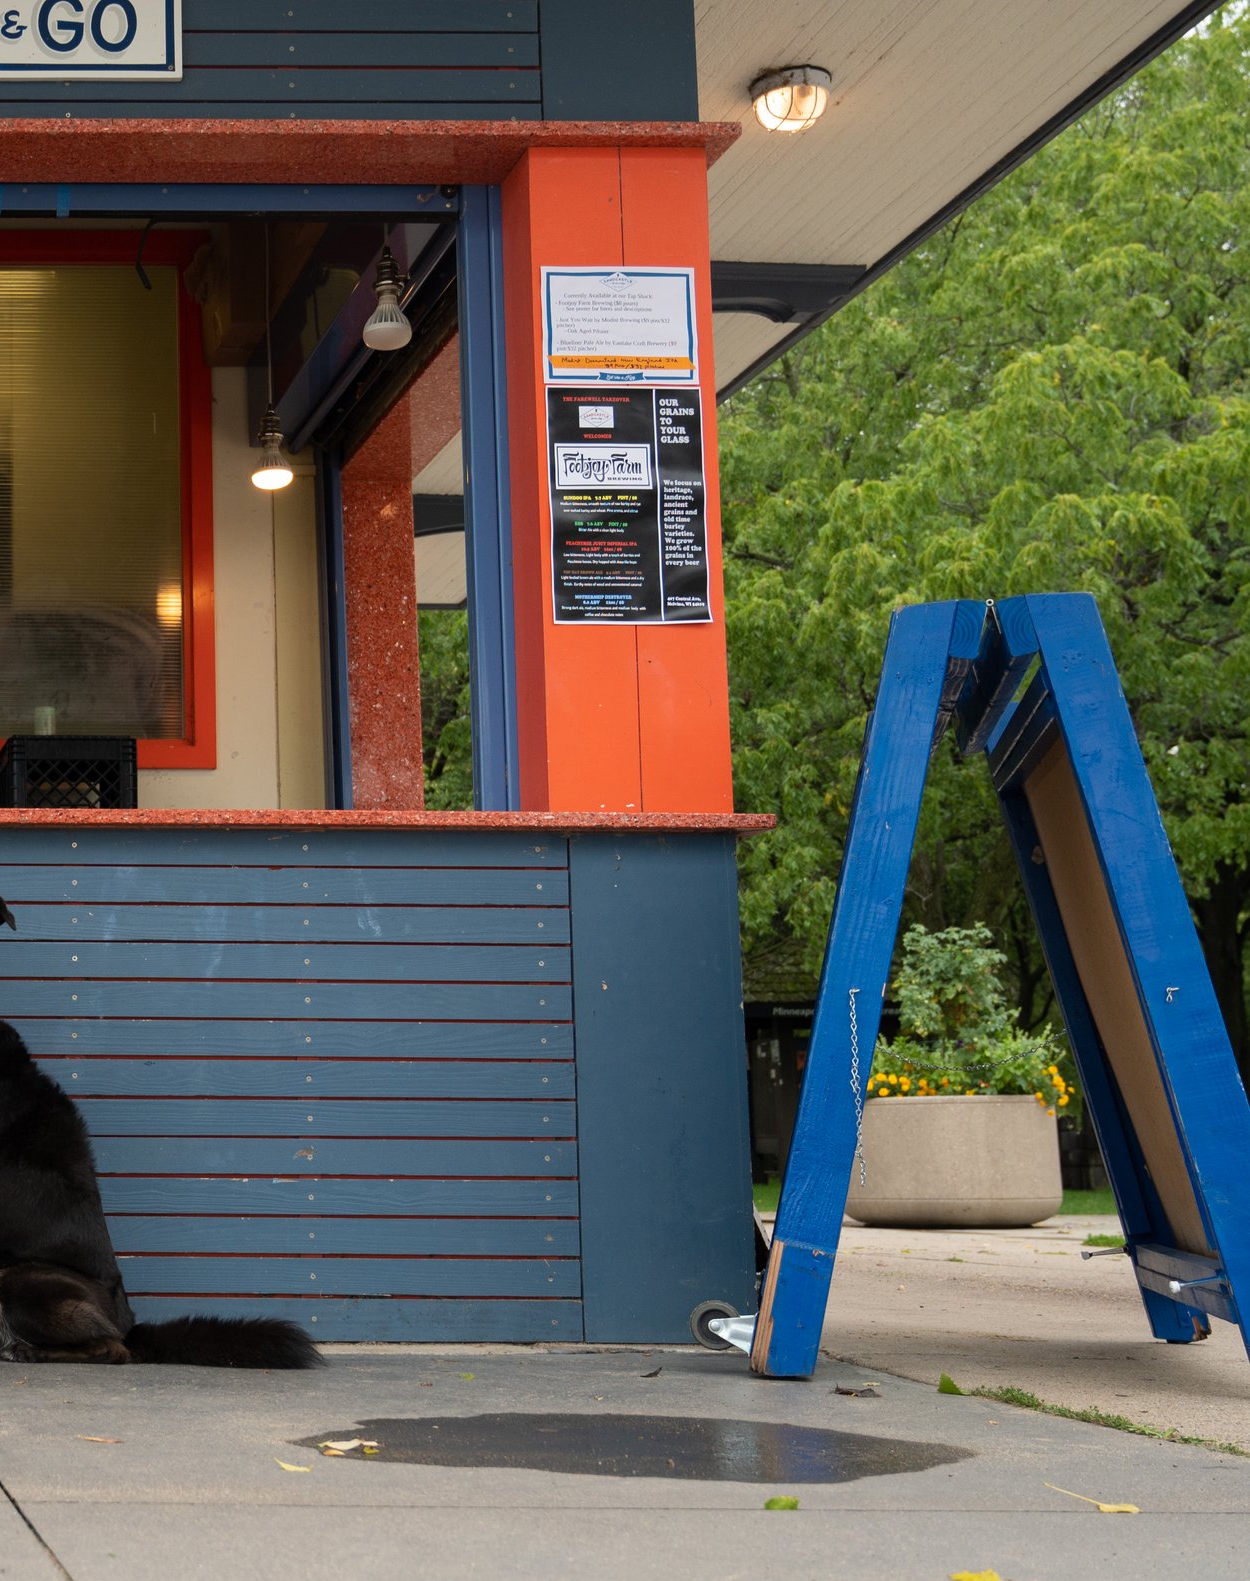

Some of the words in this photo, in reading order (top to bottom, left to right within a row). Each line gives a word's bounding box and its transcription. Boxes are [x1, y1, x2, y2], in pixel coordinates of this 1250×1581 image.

[0, 10, 28, 40] &
[37, 0, 138, 53] GO
[563, 452, 611, 482] Footjoy
[611, 452, 642, 475] Farm
